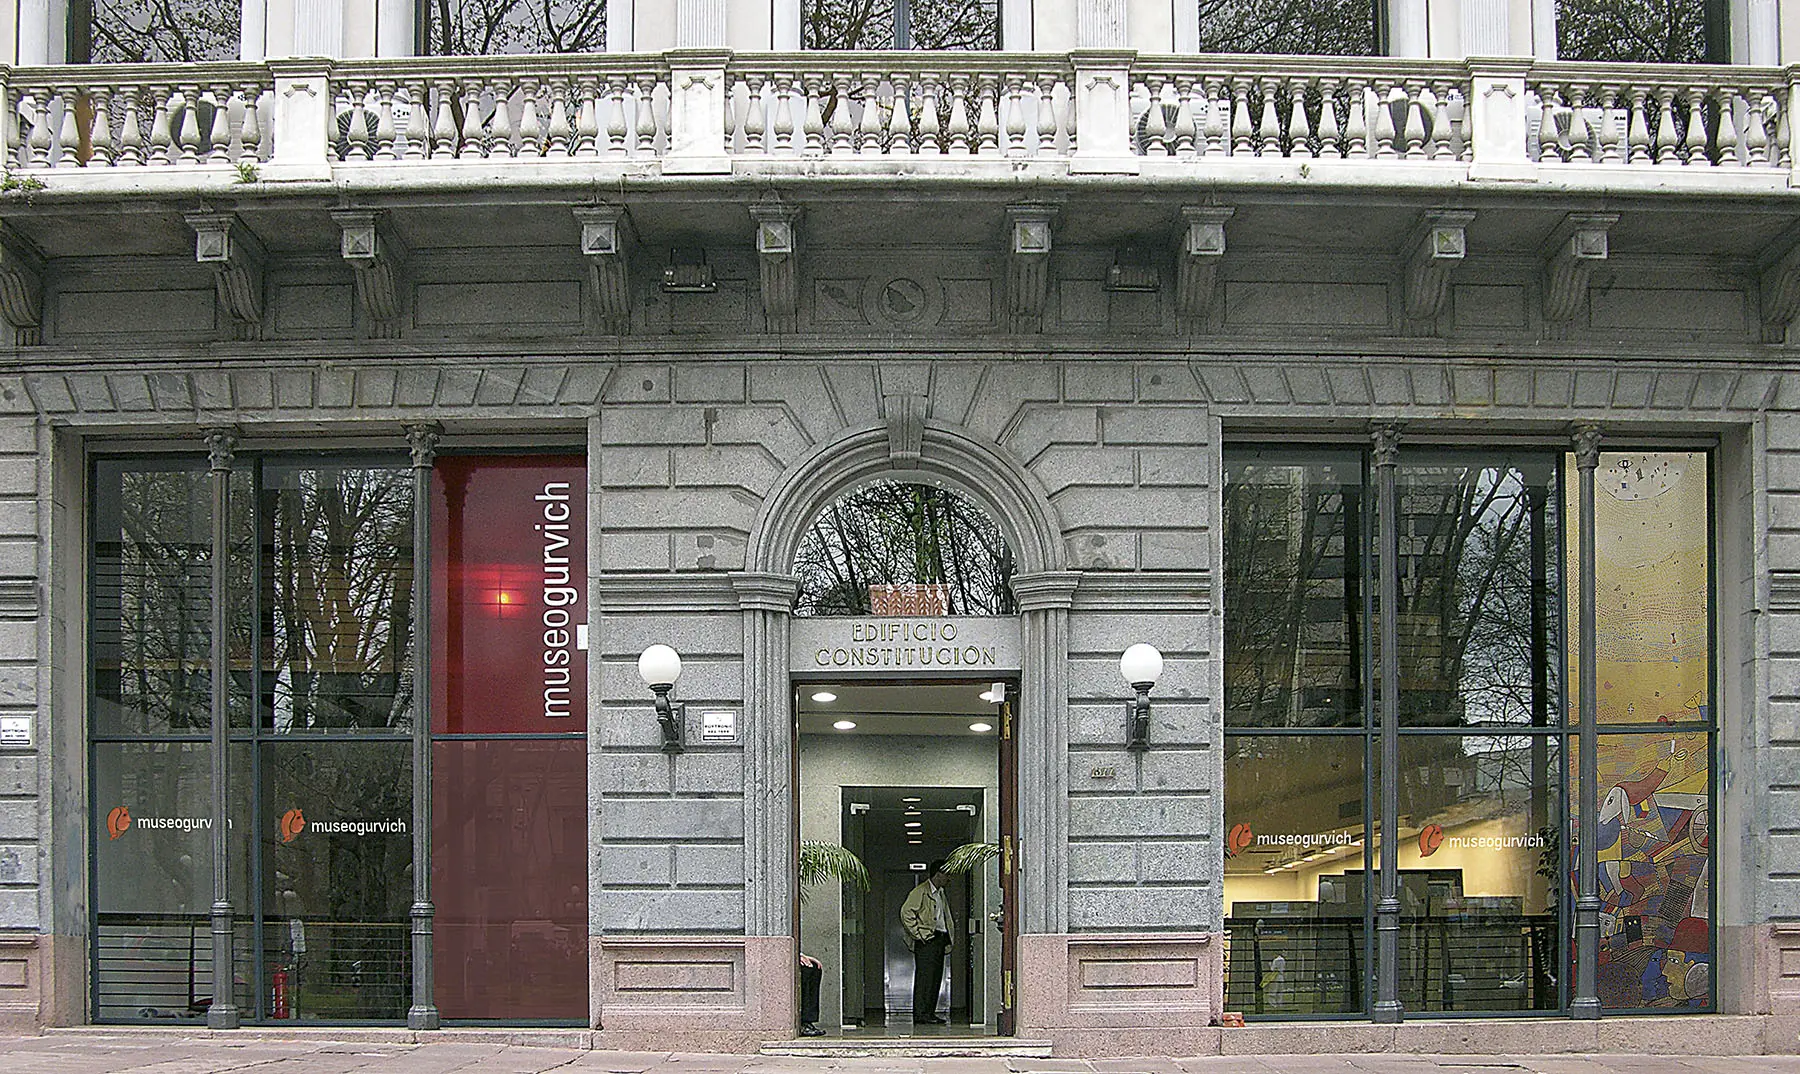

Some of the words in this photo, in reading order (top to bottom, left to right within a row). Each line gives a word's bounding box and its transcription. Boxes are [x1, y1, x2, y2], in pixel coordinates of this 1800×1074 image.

[535, 482, 578, 717] museogurvich
[852, 623, 958, 642] EDIFICIO
[311, 818, 406, 835] museogurvich
[1257, 830, 1352, 849] museogurvich
[1449, 833, 1544, 850] museogurvich
